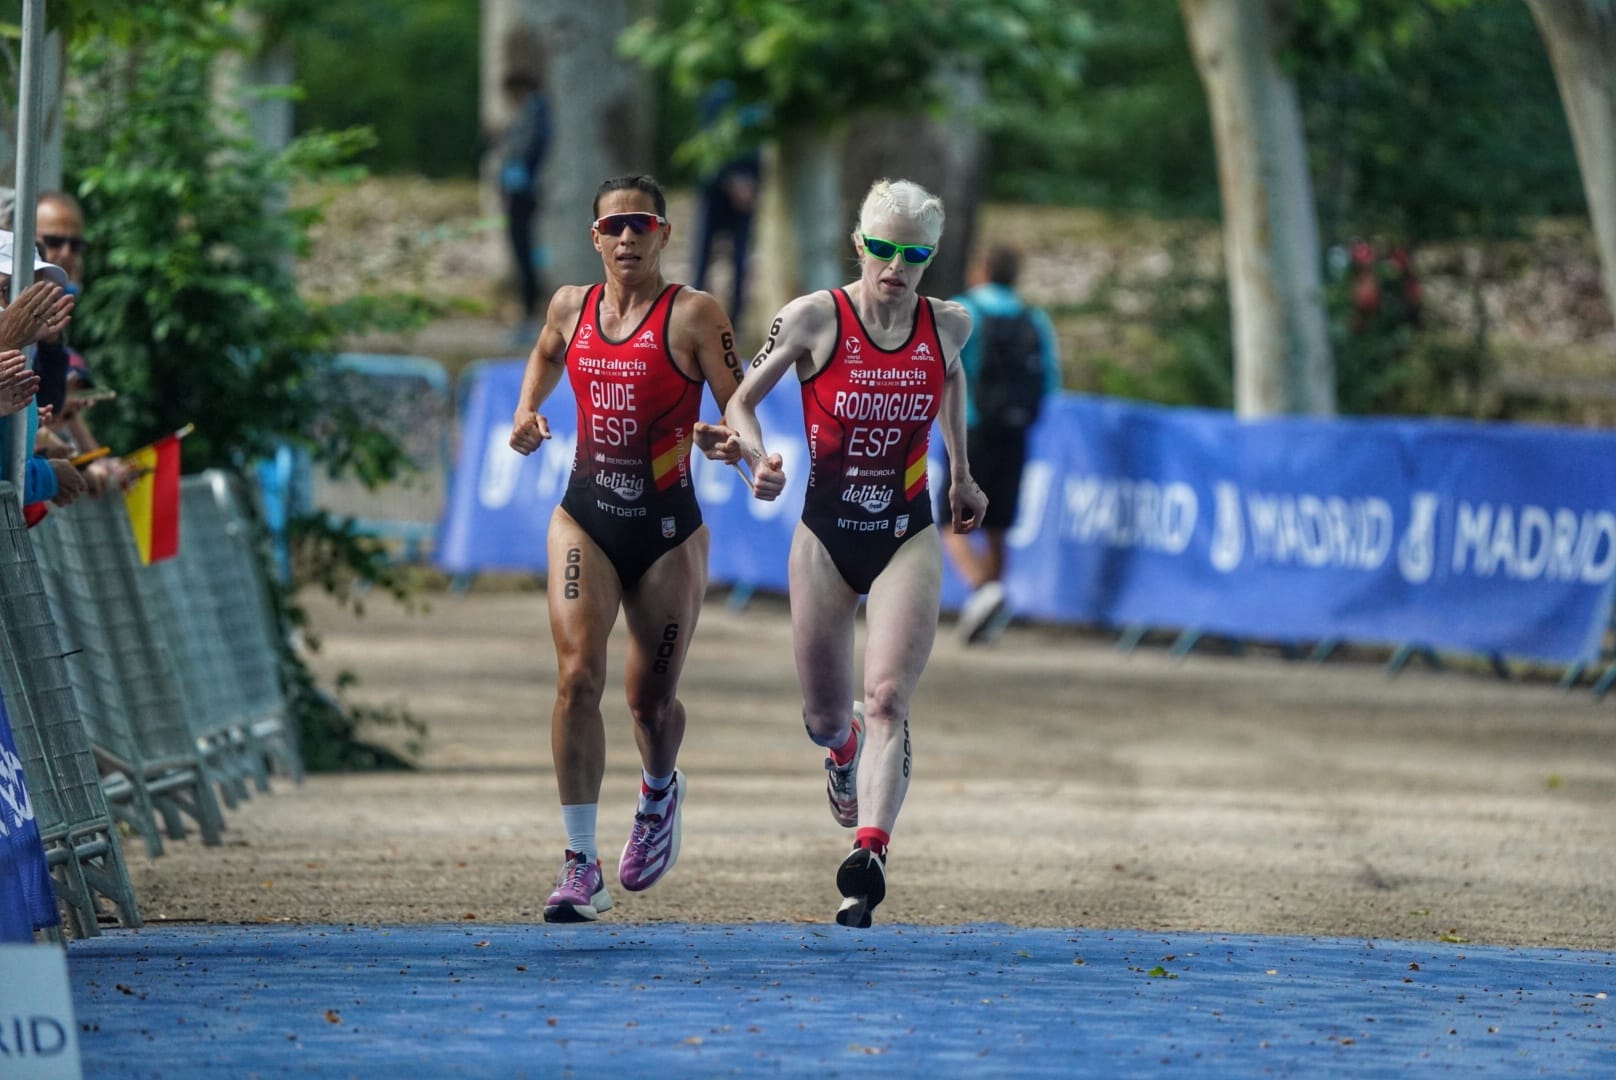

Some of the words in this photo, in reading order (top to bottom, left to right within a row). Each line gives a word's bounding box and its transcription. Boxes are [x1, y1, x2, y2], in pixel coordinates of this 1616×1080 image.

[590, 380, 637, 411] GUIDE
[834, 391, 934, 421] RODRIGUEZ
[592, 414, 638, 447] ESP
[848, 427, 902, 457] ESP
[859, 469, 896, 477] IBERDROLA
[1452, 501, 1616, 584] MADRID
[564, 548, 581, 600] 606
[653, 623, 679, 675] 606
